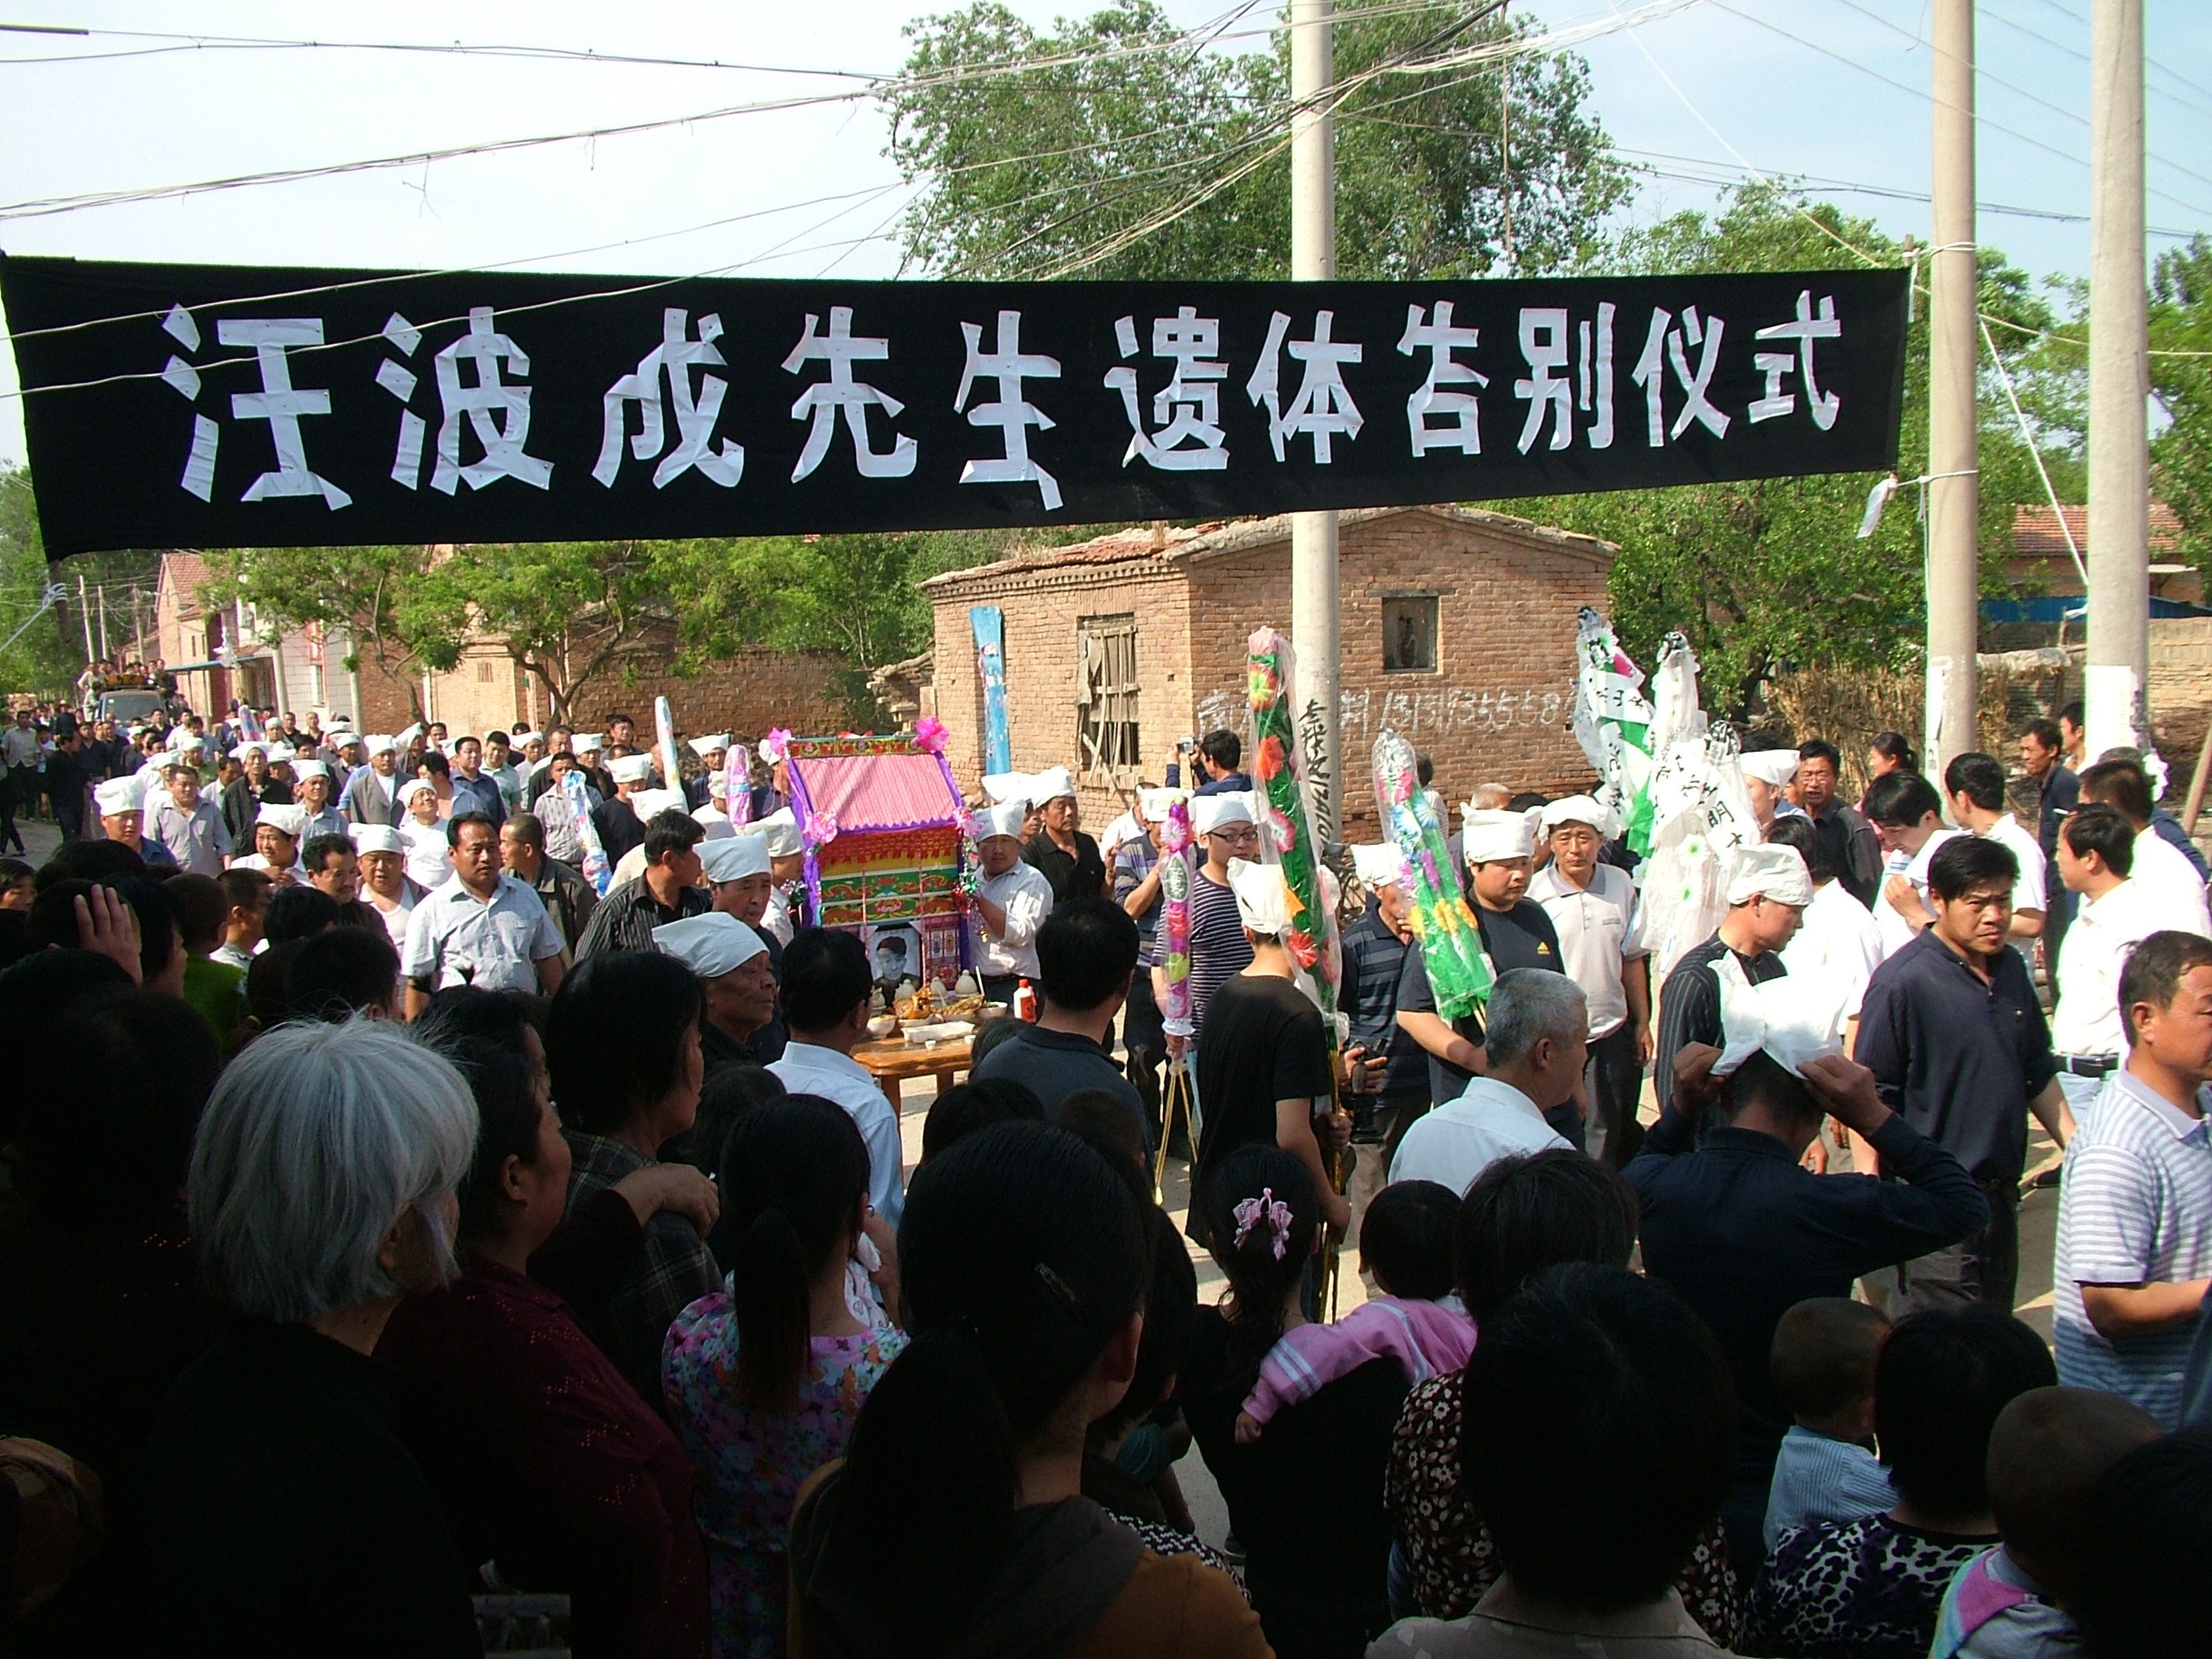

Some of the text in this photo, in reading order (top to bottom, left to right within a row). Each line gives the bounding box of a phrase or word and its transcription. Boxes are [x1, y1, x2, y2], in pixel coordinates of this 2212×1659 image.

[161, 289, 1842, 510] 汪波成先生遗体告别仪式
